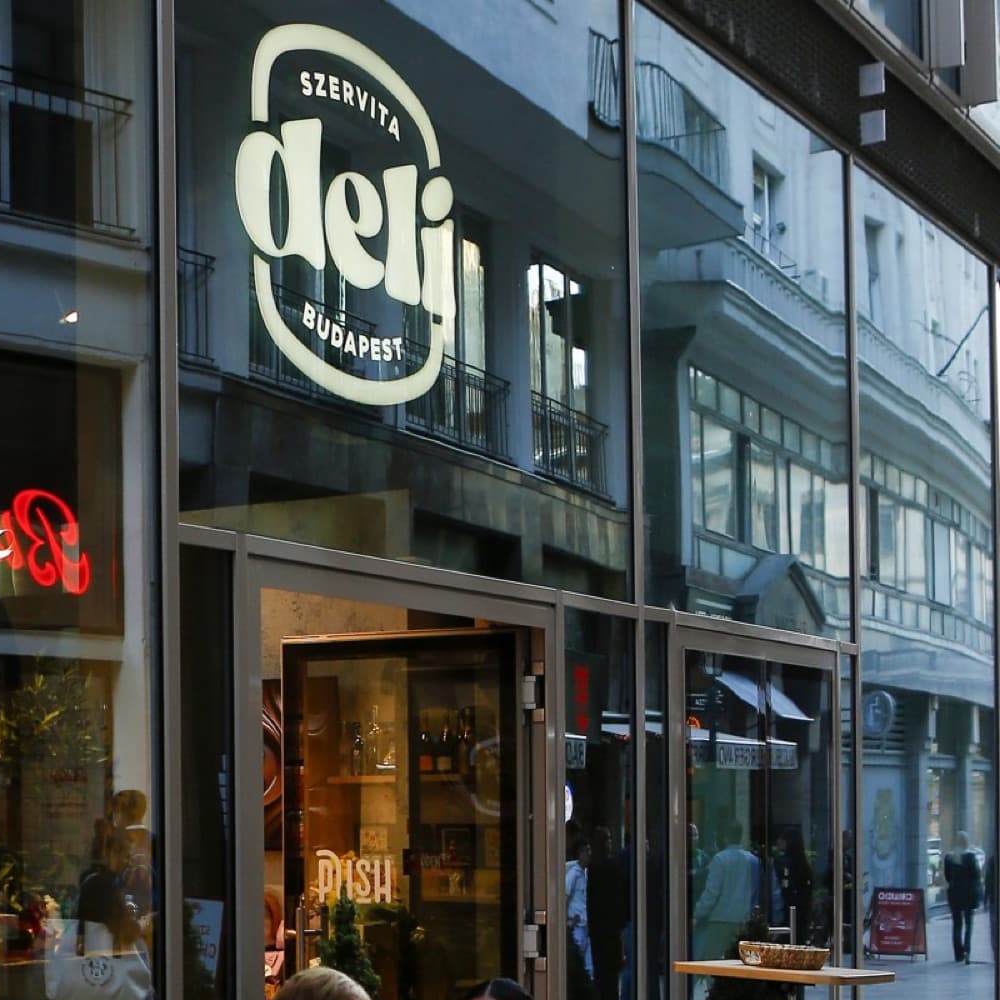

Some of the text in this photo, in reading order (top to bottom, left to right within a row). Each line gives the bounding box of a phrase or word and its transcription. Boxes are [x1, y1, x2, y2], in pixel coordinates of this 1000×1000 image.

[299, 70, 401, 141] SZERVITA
[235, 118, 456, 318] deli
[301, 301, 404, 361] BUDAPEST
